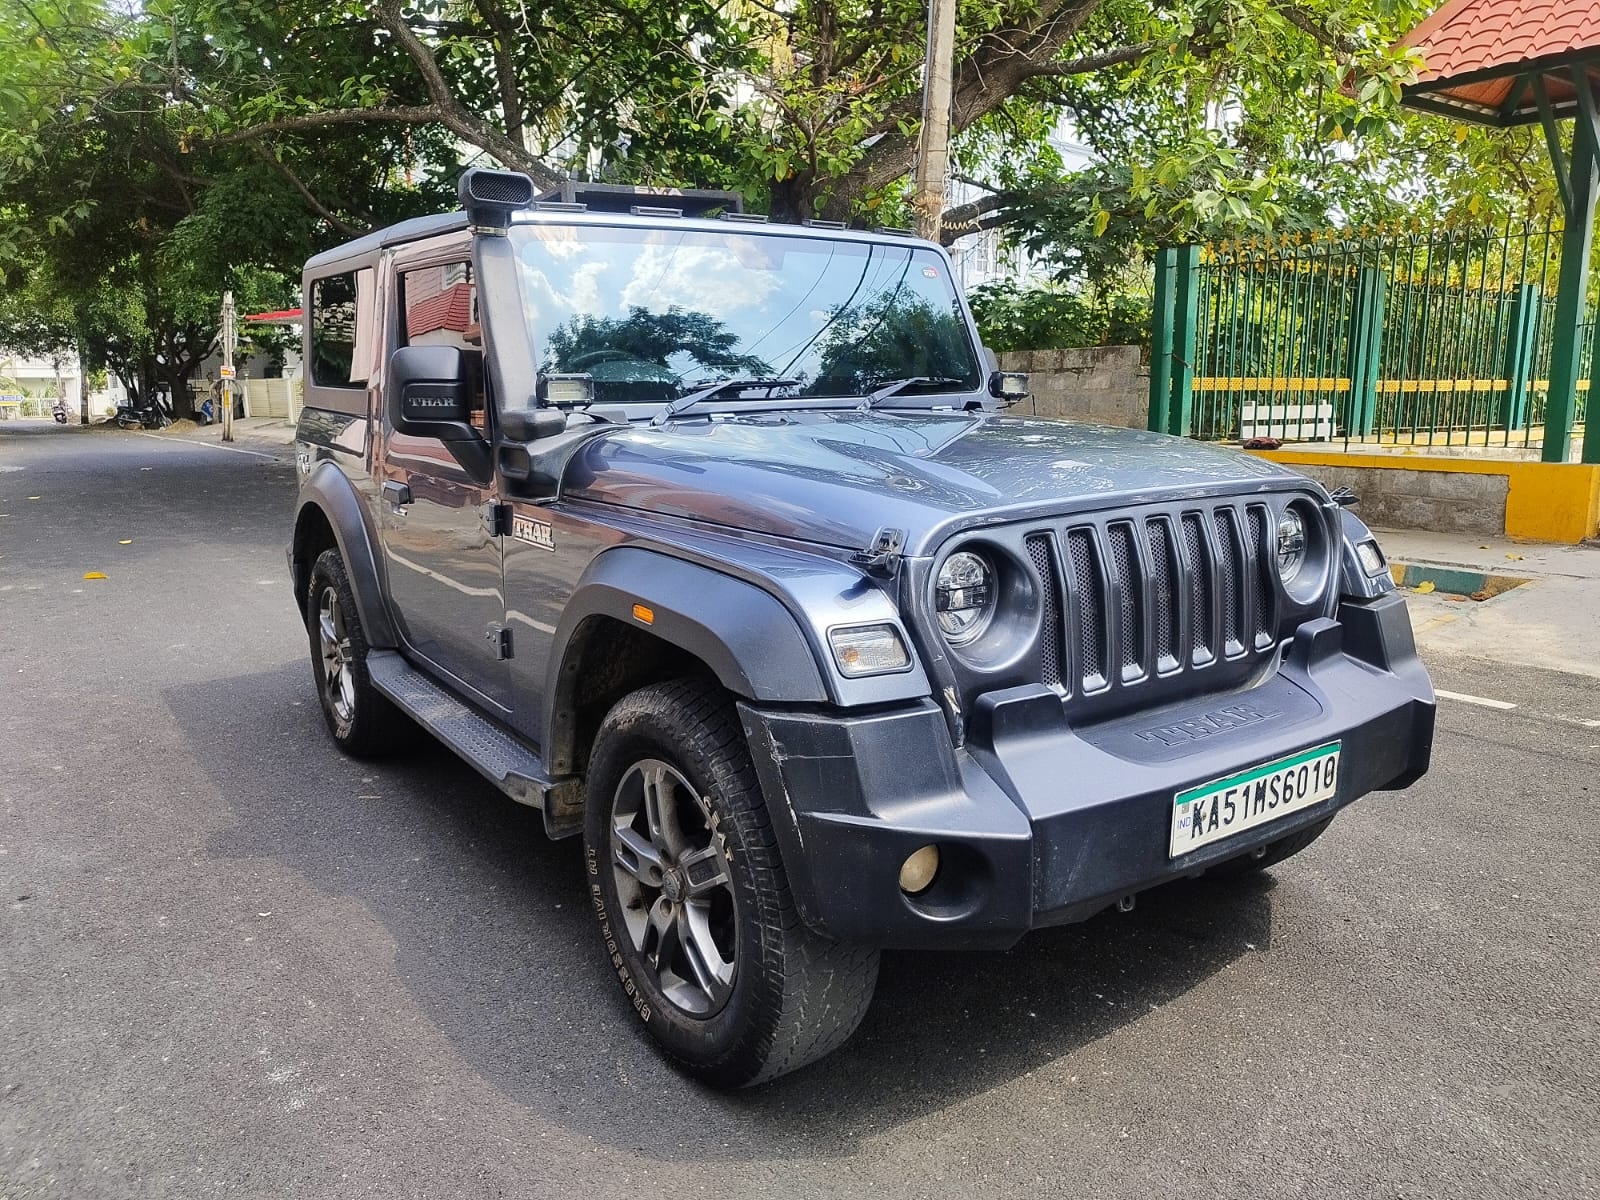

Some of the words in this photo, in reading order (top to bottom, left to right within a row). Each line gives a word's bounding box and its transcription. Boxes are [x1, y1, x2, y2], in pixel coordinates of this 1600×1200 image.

[408, 397, 458, 407] THAR
[513, 516, 555, 548] THAR
[1134, 703, 1283, 747] THAR
[1190, 755, 1336, 840] KA51MS6010
[1177, 816, 1191, 830] IND
